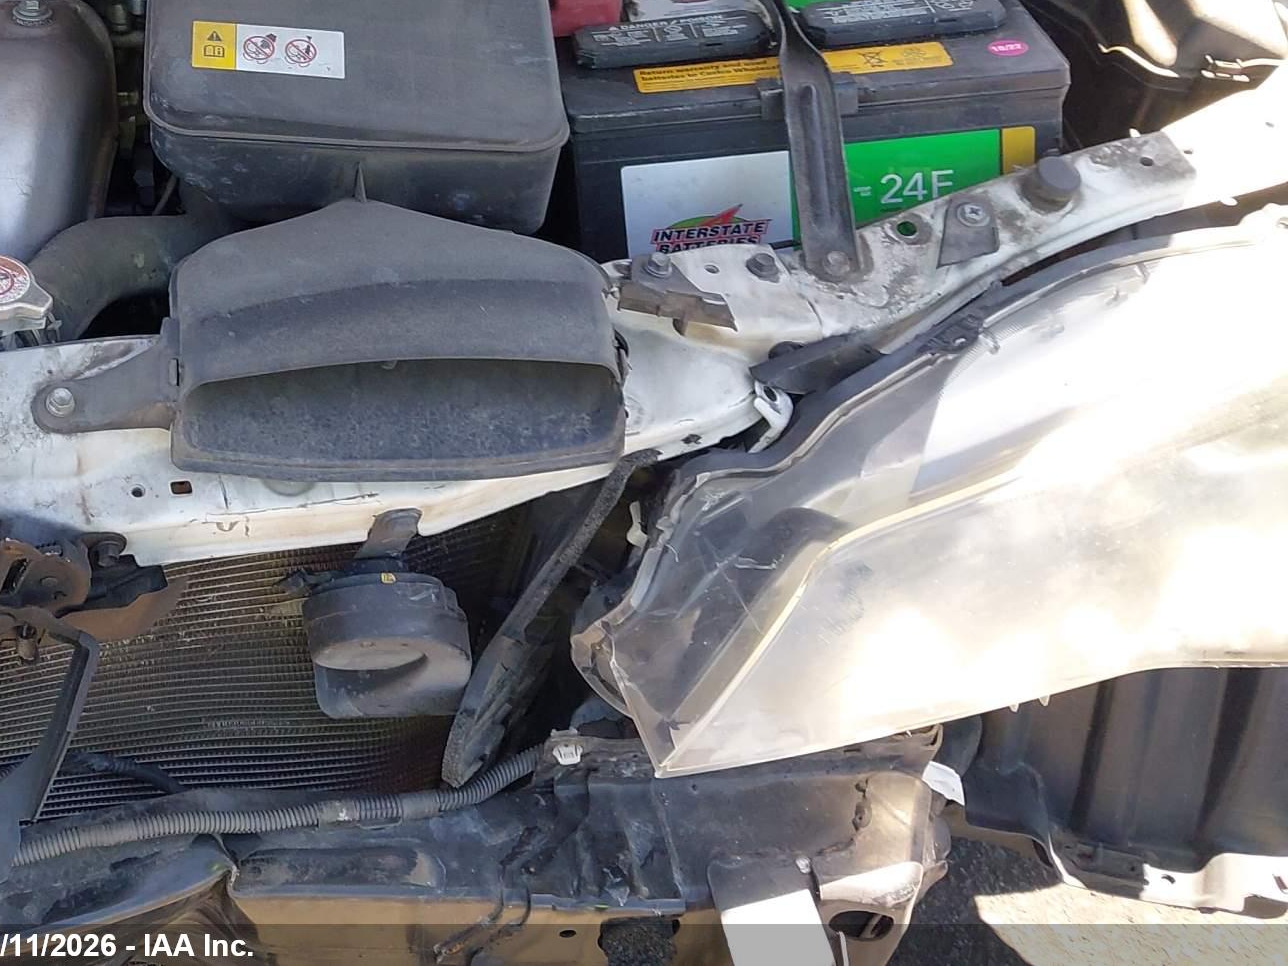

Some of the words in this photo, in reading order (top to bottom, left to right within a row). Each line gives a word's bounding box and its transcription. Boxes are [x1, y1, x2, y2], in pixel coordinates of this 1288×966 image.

[621, 21, 668, 29] DANGER
[641, 73, 685, 81] batteries
[880, 169, 954, 204] 24F
[654, 221, 766, 243] INTERSTATE
[659, 236, 758, 255] BATTERIES
